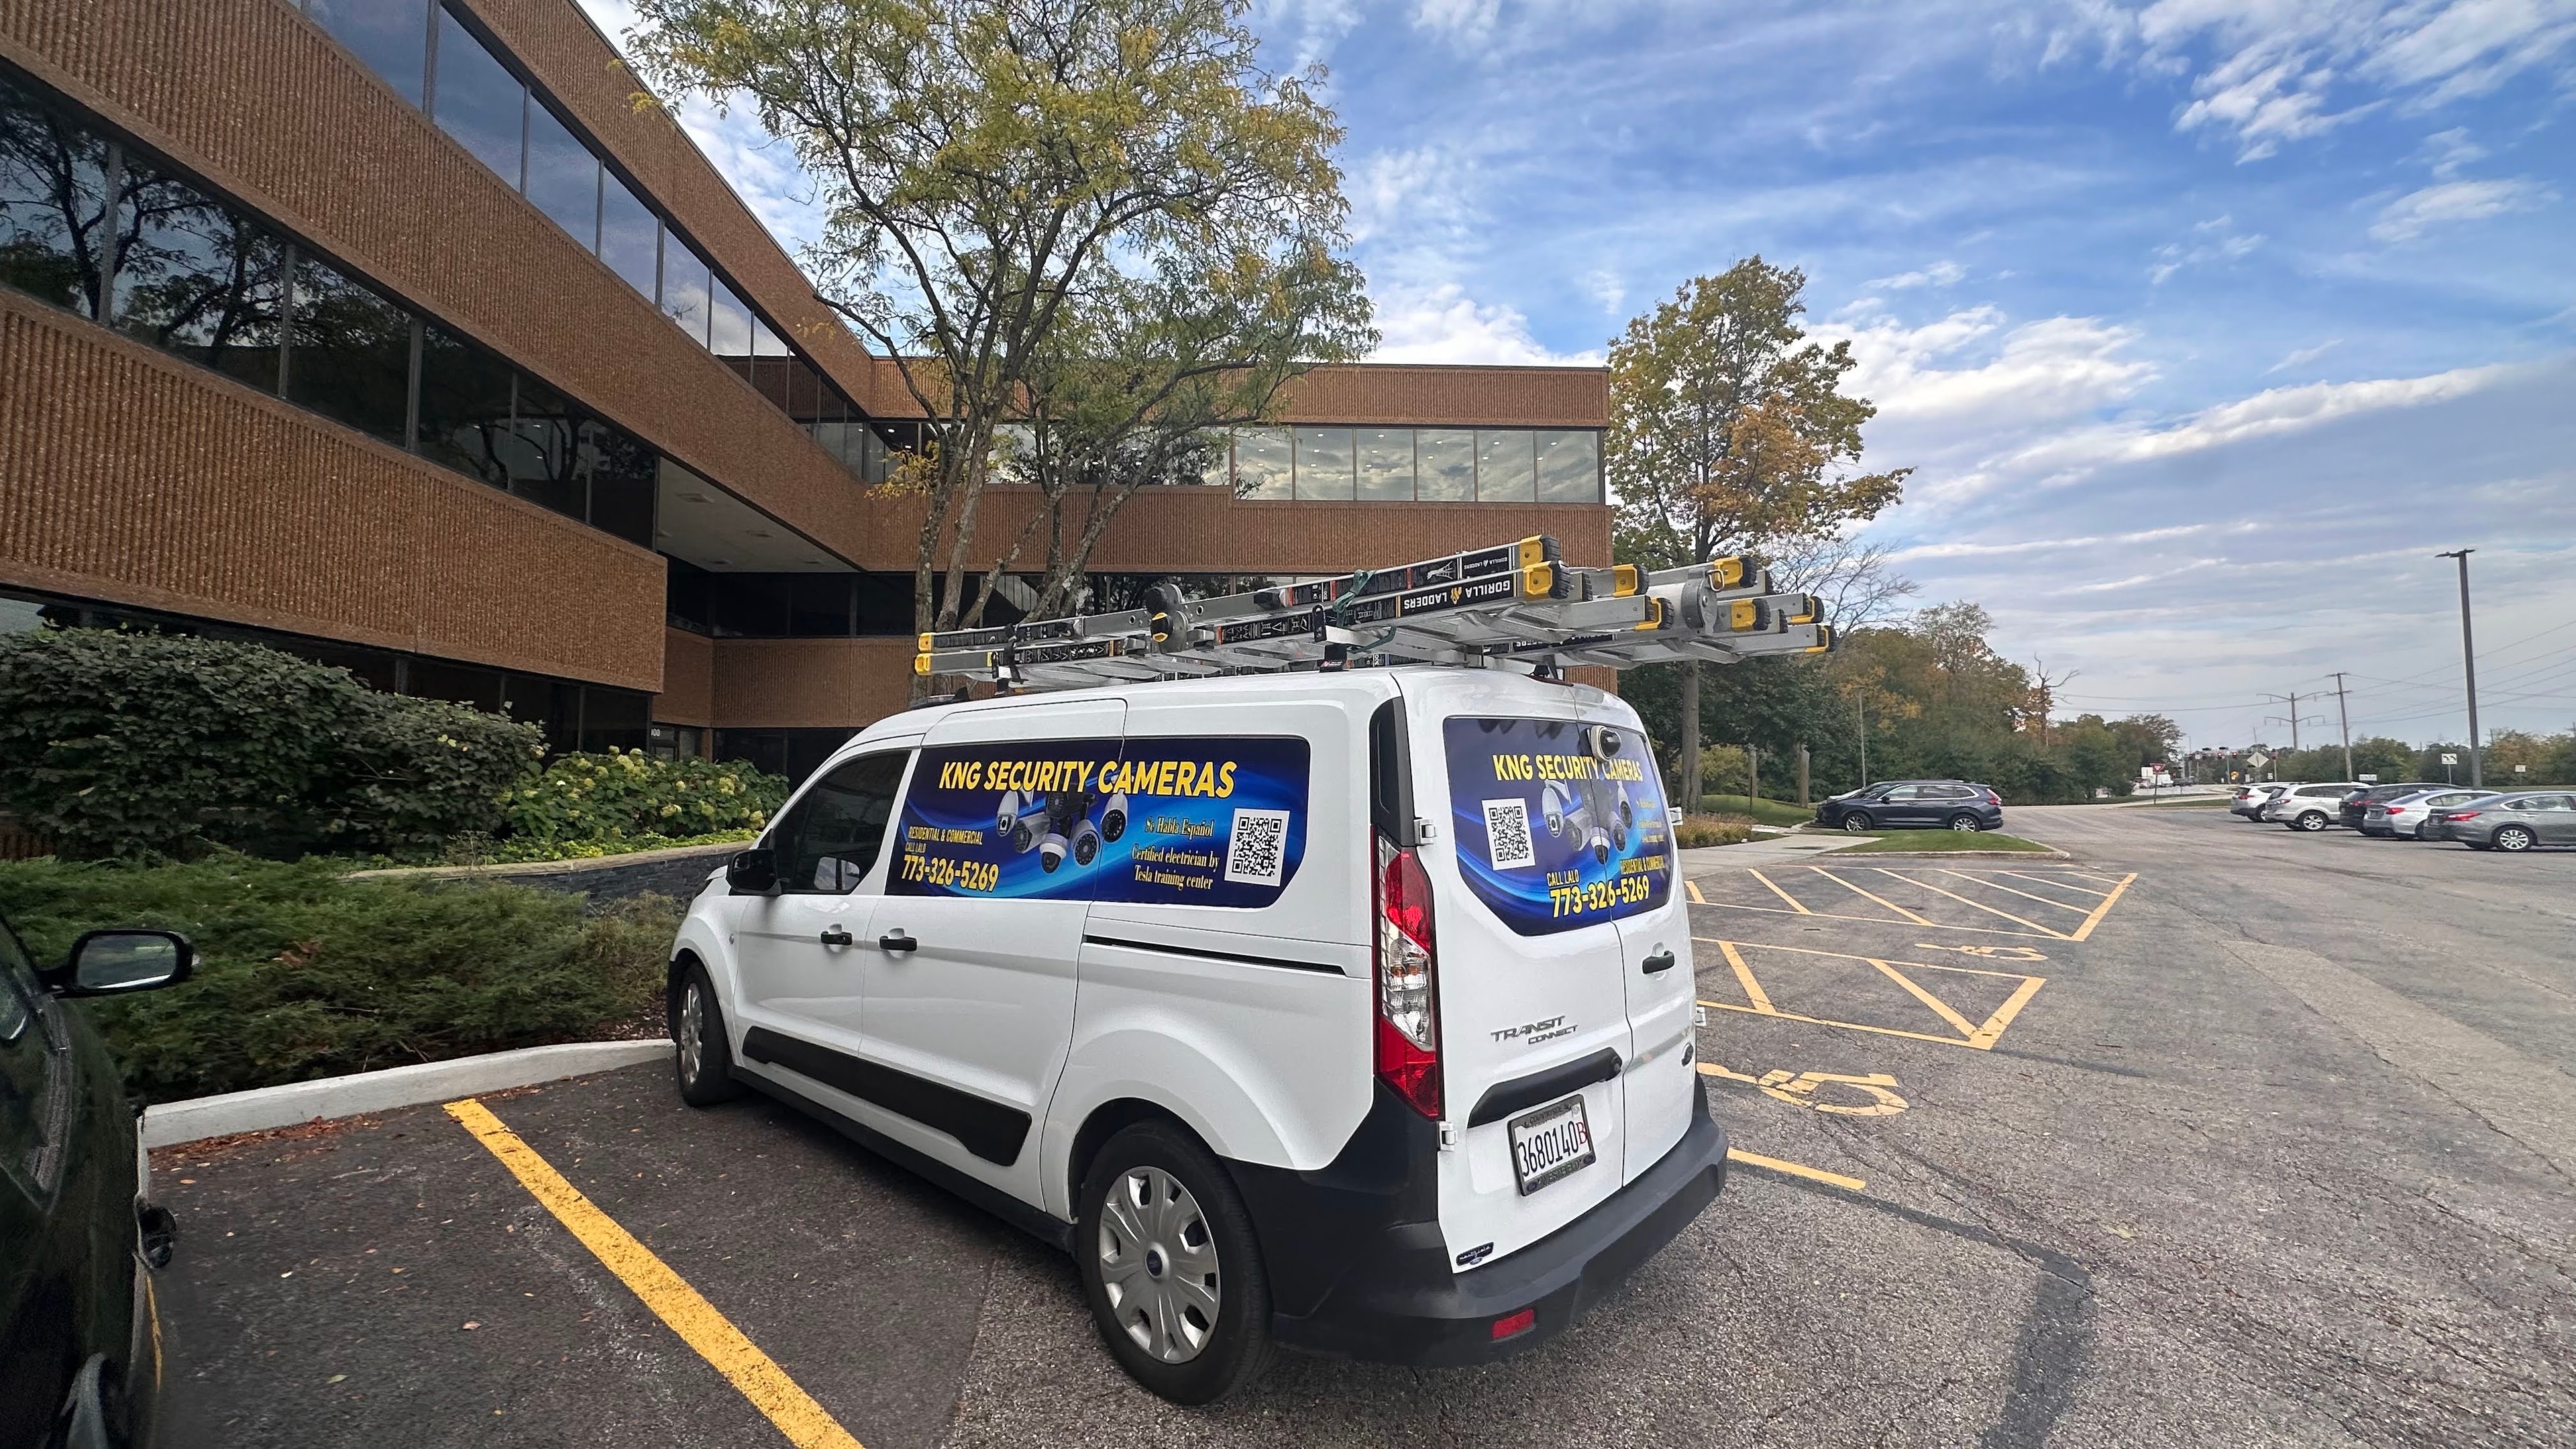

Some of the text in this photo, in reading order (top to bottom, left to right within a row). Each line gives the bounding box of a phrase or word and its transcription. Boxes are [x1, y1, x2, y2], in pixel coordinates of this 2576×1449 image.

[1403, 580, 1510, 609] GORILLA LADDERS
[938, 761, 1238, 798] KNG SECURITY CAMERAS
[1493, 754, 1644, 782] KNG SECURITY CAMERAS
[908, 826, 983, 845] RESIDENTIAL & COMMERCIAL
[1145, 816, 1215, 840] Se Habla Español
[1132, 843, 1220, 873] Certified electrician by
[901, 854, 1000, 892] 773-326-5269
[1134, 864, 1214, 892] Tesla training center
[1546, 869, 1579, 887] CALL LALO
[1550, 875, 1650, 918] 773-326-5269
[1491, 1015, 1566, 1042] TRANSIT
[1528, 1024, 1578, 1044] CONNECT
